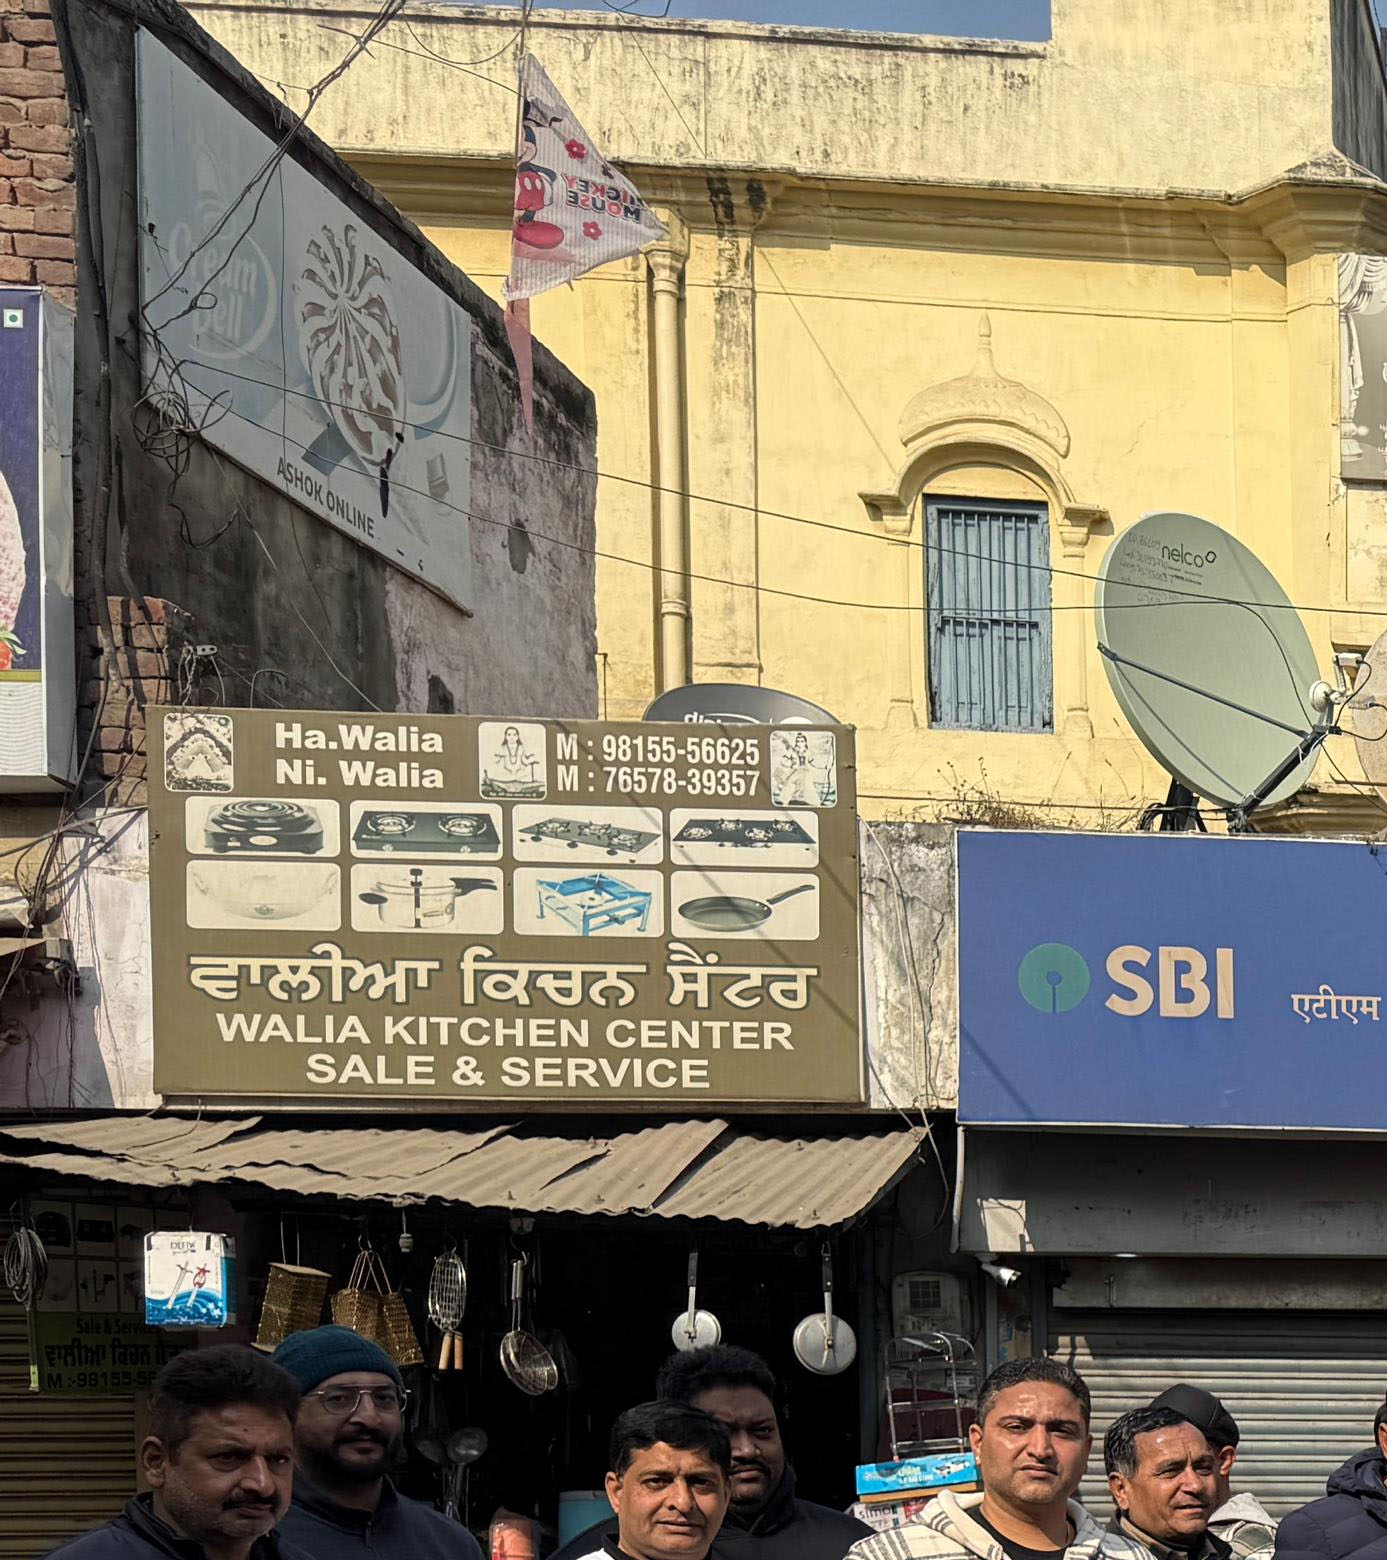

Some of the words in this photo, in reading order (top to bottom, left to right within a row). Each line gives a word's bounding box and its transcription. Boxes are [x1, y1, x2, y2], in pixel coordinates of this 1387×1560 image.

[277, 455, 324, 506] ASHOK
[326, 489, 375, 539] ONLINE
[1162, 544, 1204, 568] nelco
[275, 722, 444, 755] Ha.Walia
[556, 733, 579, 760] M
[602, 736, 760, 766] 98155-56625
[275, 758, 331, 787] Ni.
[339, 759, 444, 789] Walia
[556, 765, 579, 791] M
[602, 766, 760, 797] 76578-39357
[187, 942, 441, 1007] ਵਾਲੀਆ
[460, 947, 650, 1009] ਕਿਚਨ
[665, 941, 819, 1012] ਸੈਂਟਰ
[1105, 945, 1234, 1019] SBI
[1291, 984, 1381, 1025] एटीएम
[216, 1013, 371, 1045] WALIA
[384, 1015, 590, 1048] KITCHEN
[604, 1018, 795, 1051] CENTER
[305, 1053, 438, 1085] SALE
[452, 1055, 487, 1087] &
[500, 1056, 710, 1090] SERVICE
